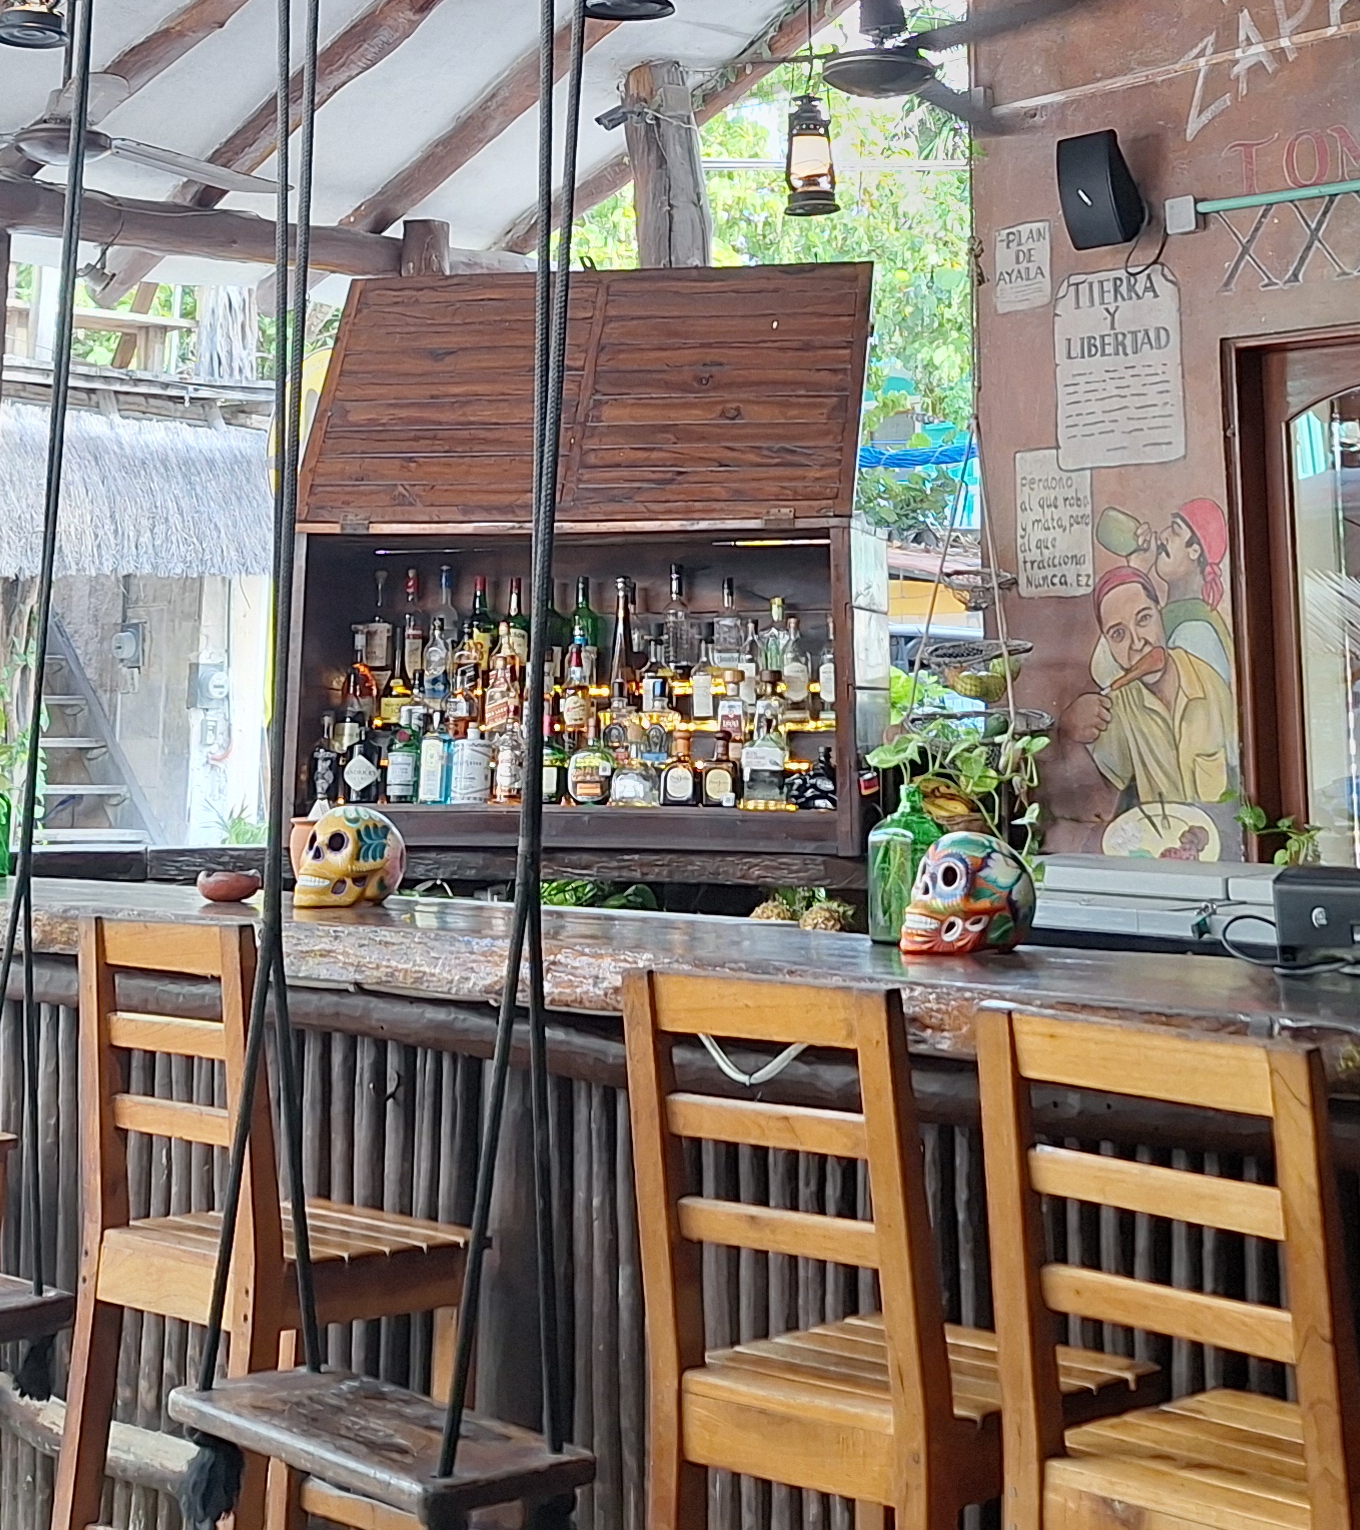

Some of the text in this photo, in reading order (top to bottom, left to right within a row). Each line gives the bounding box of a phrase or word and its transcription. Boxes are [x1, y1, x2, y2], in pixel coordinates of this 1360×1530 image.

[1014, 247, 1037, 266] DE
[995, 265, 1046, 288] AYALA
[1070, 272, 1161, 310] TIERRA
[1103, 305, 1121, 331] Y
[1065, 326, 1171, 360] LIBERTAD
